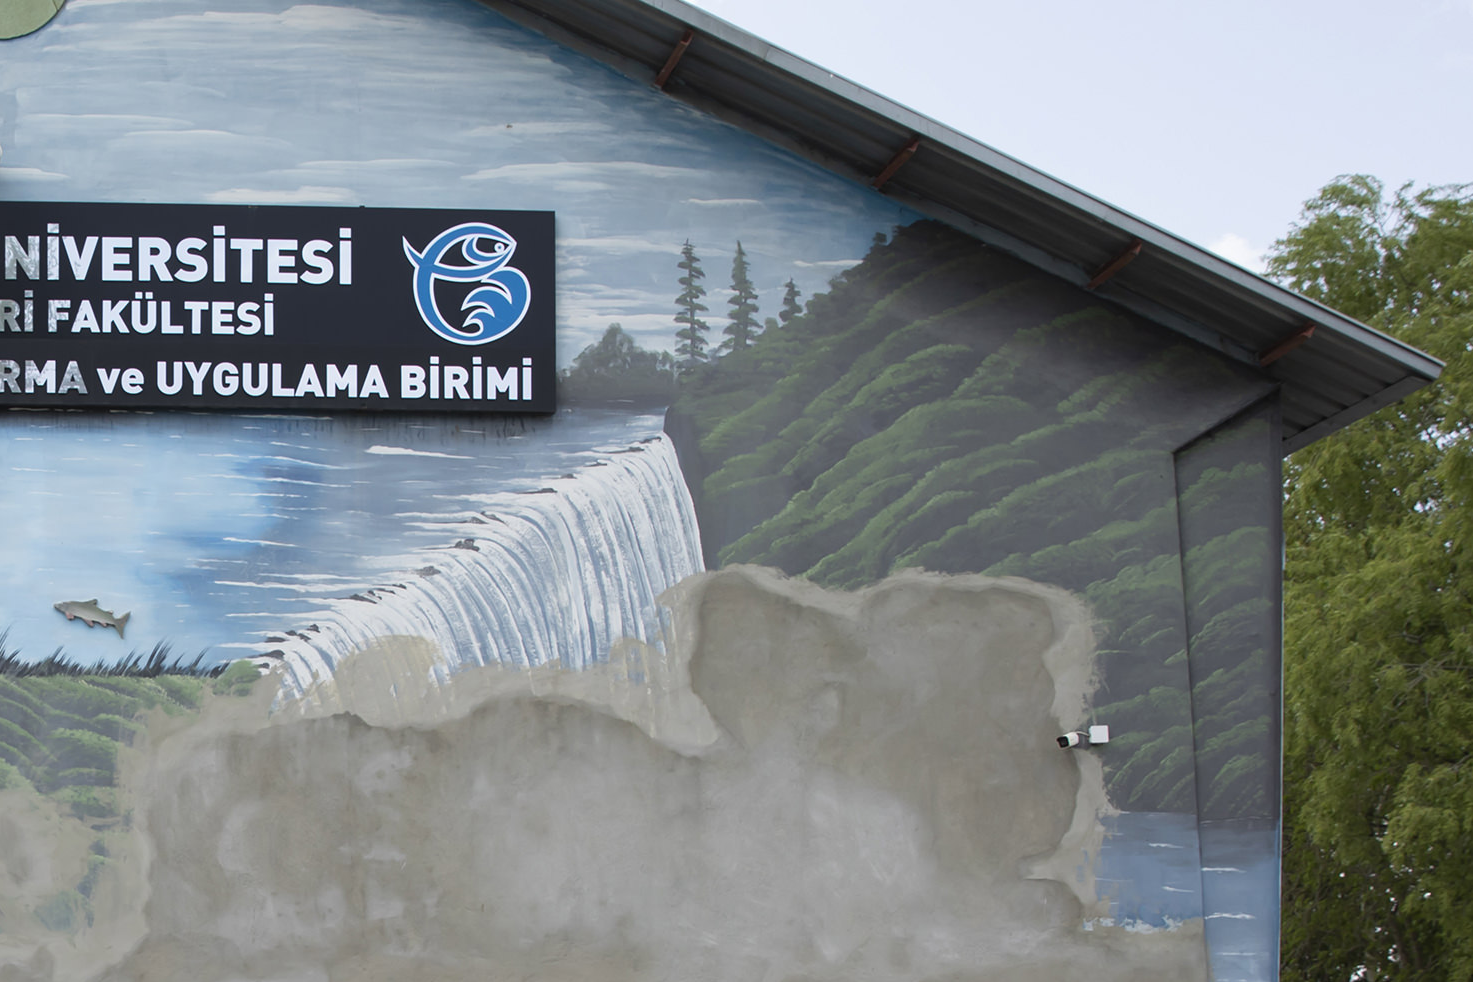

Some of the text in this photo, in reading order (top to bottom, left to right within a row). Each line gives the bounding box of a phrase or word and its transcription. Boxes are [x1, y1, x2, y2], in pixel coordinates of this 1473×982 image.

[47, 291, 275, 336] FAKÜLTESİ
[96, 367, 145, 395] ve
[156, 360, 390, 399] UYGULAMA
[400, 355, 533, 401] BİRİMİ
